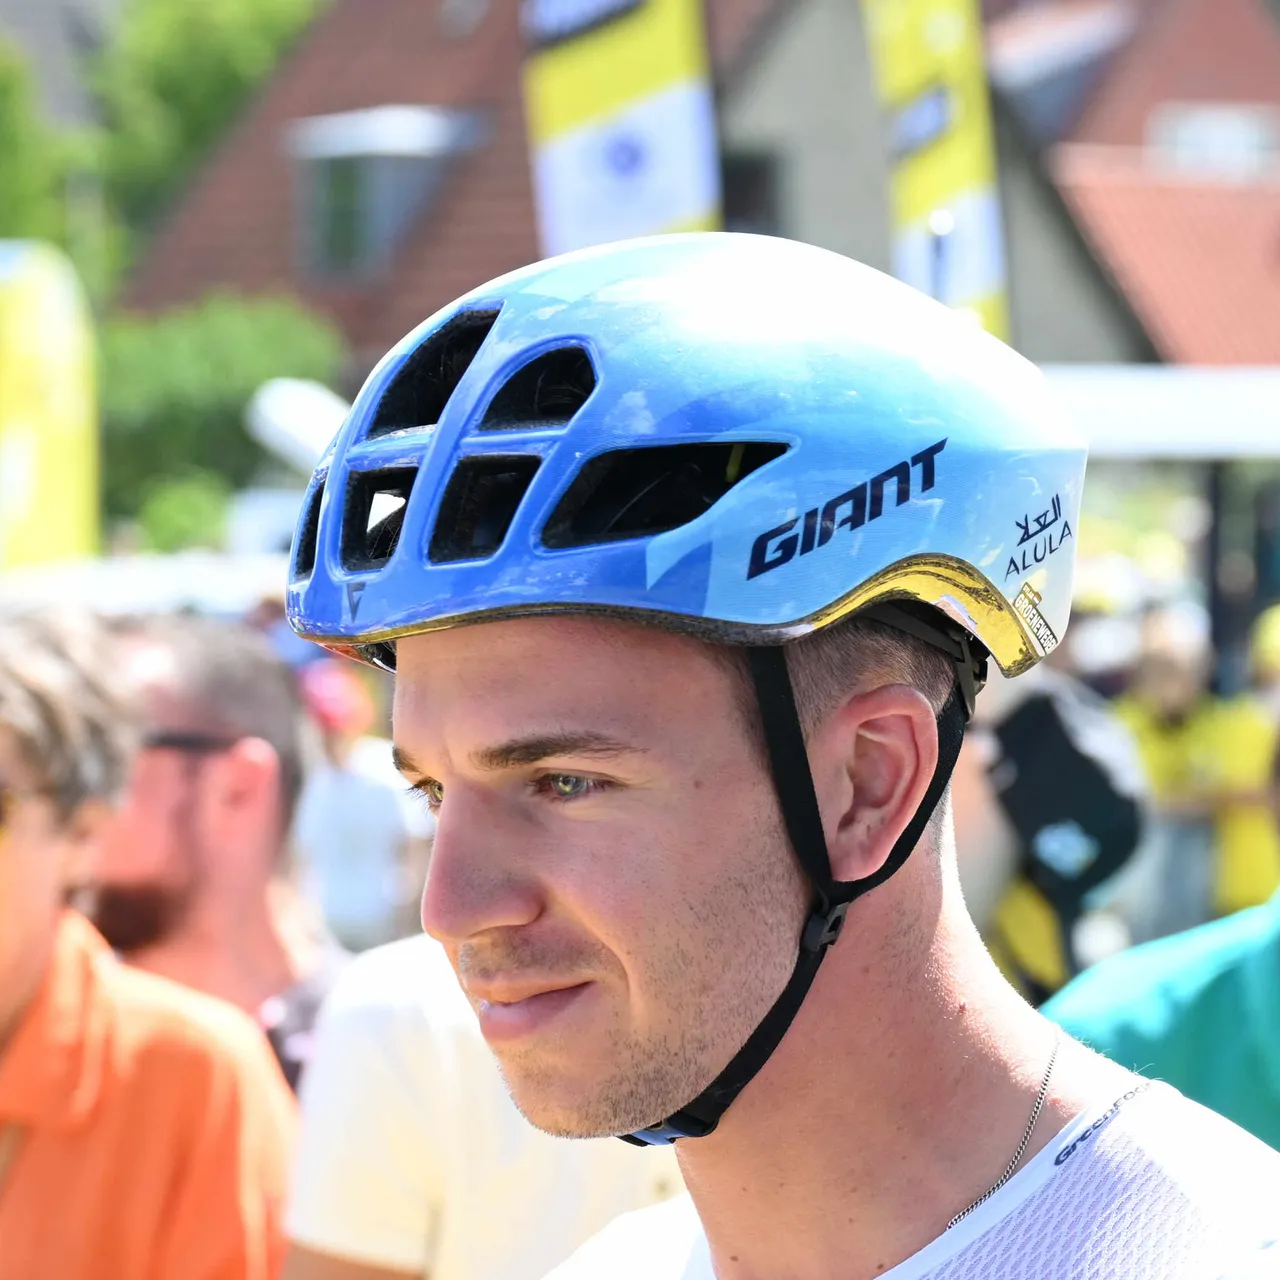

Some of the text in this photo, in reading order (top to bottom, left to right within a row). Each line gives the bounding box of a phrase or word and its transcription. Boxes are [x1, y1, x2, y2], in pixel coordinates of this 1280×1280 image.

[747, 437, 949, 581] GIANT
[1004, 520, 1072, 582] ALULA
[1014, 593, 1058, 651] GROENEWEGE
